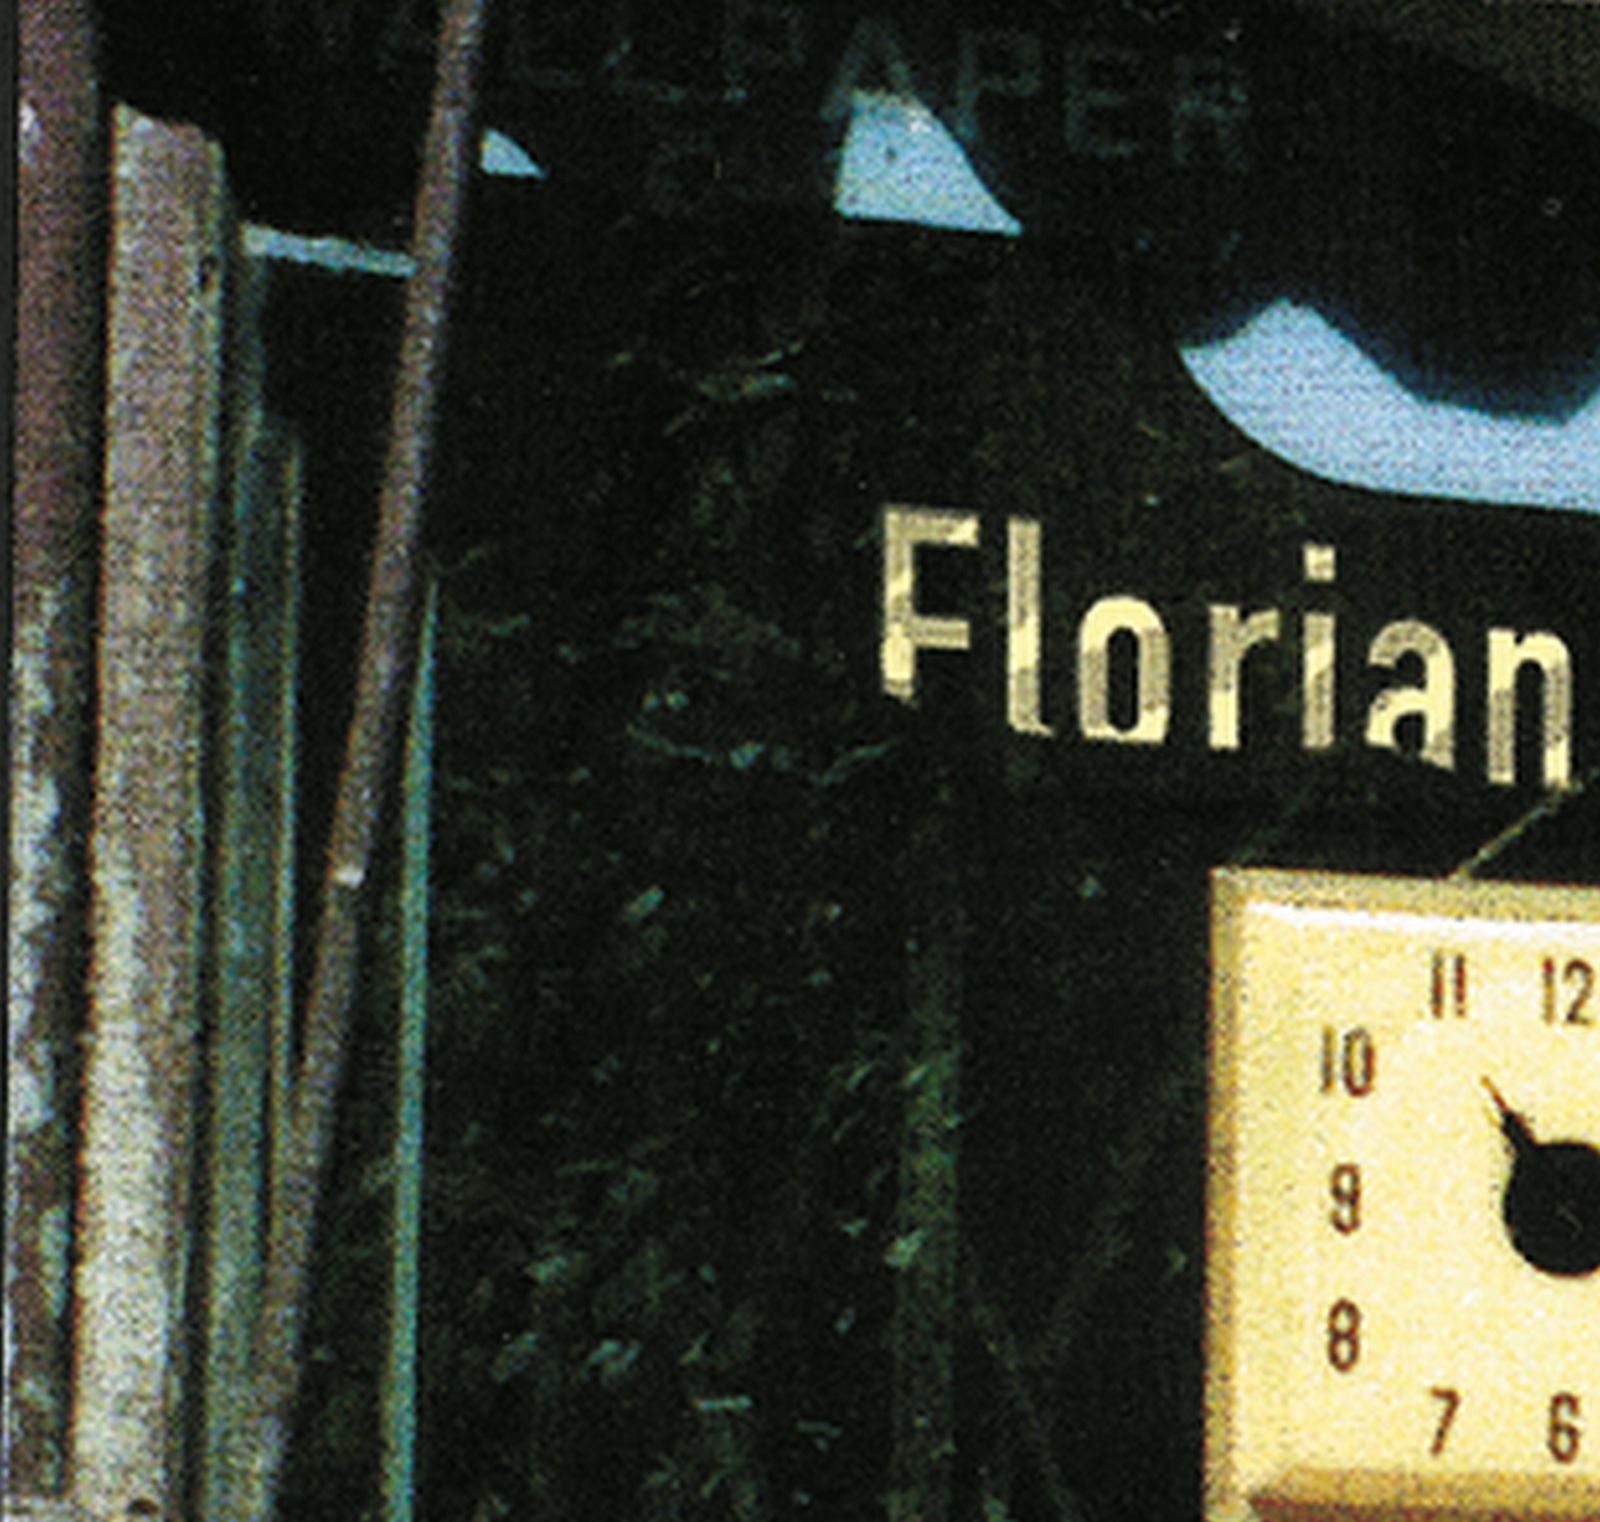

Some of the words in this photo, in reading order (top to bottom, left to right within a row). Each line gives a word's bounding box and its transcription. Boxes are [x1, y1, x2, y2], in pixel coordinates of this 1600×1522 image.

[1429, 948, 1468, 1021] 11
[1541, 956, 1596, 1027] 12
[1319, 1024, 1376, 1098] 10
[1329, 1162, 1362, 1236] 9
[1326, 1298, 1361, 1374] 8
[1429, 1386, 1461, 1456] 7
[1547, 1391, 1581, 1466] 6
